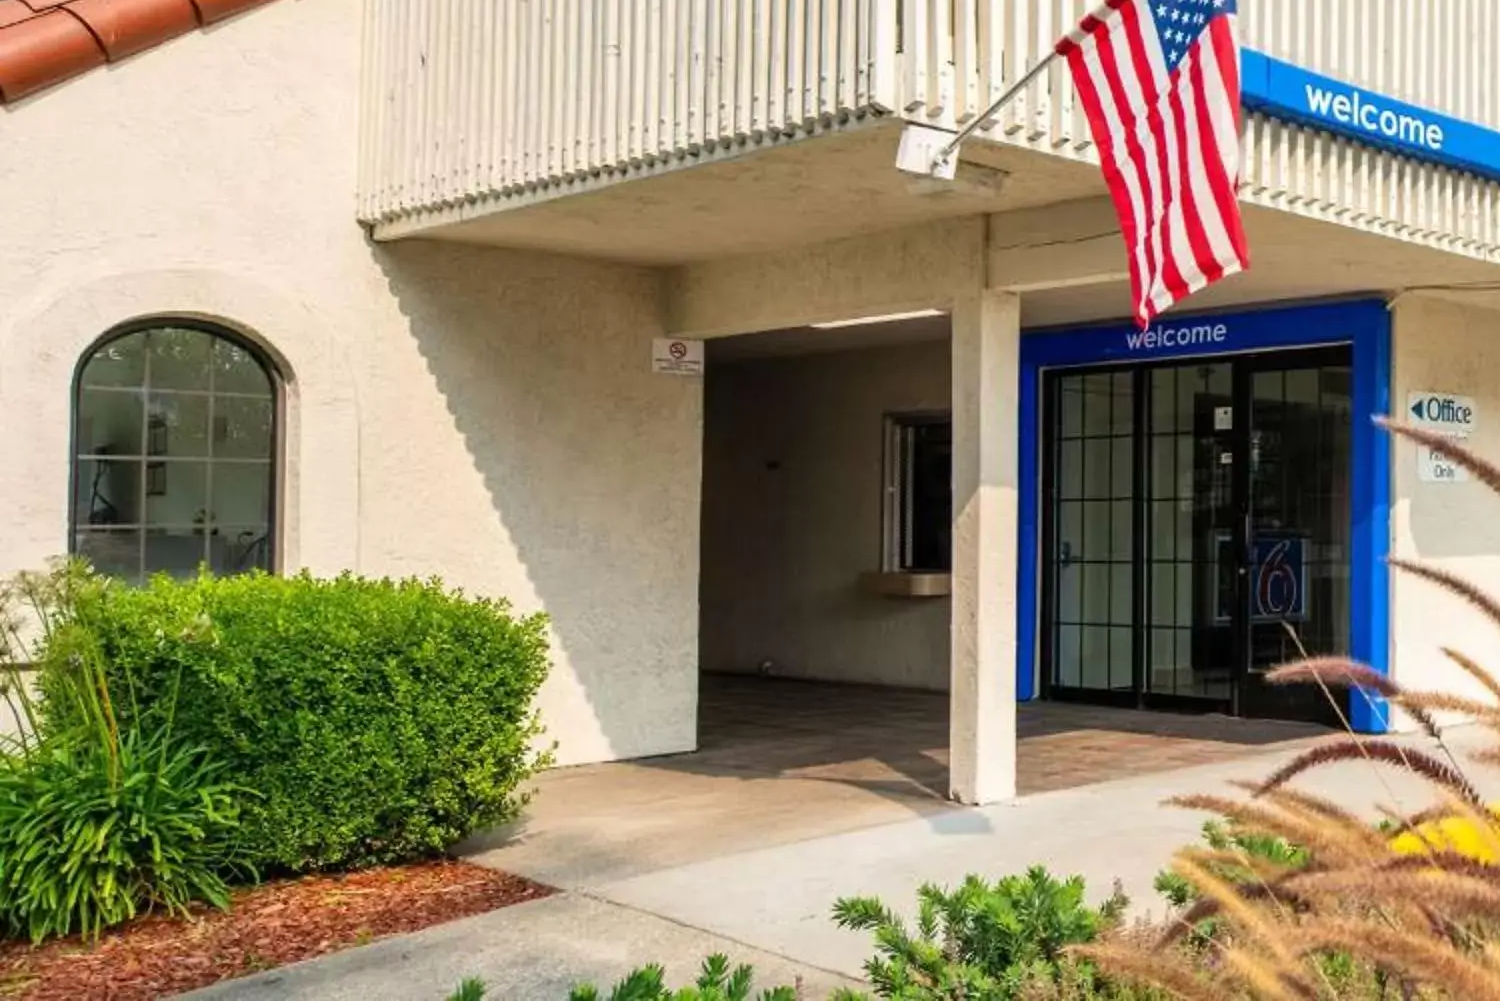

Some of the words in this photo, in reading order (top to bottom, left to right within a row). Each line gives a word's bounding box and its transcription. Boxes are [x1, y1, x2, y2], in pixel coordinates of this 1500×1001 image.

[1305, 84, 1443, 149] welcome
[1126, 323, 1227, 350] welcome
[1427, 397, 1472, 424] Office
